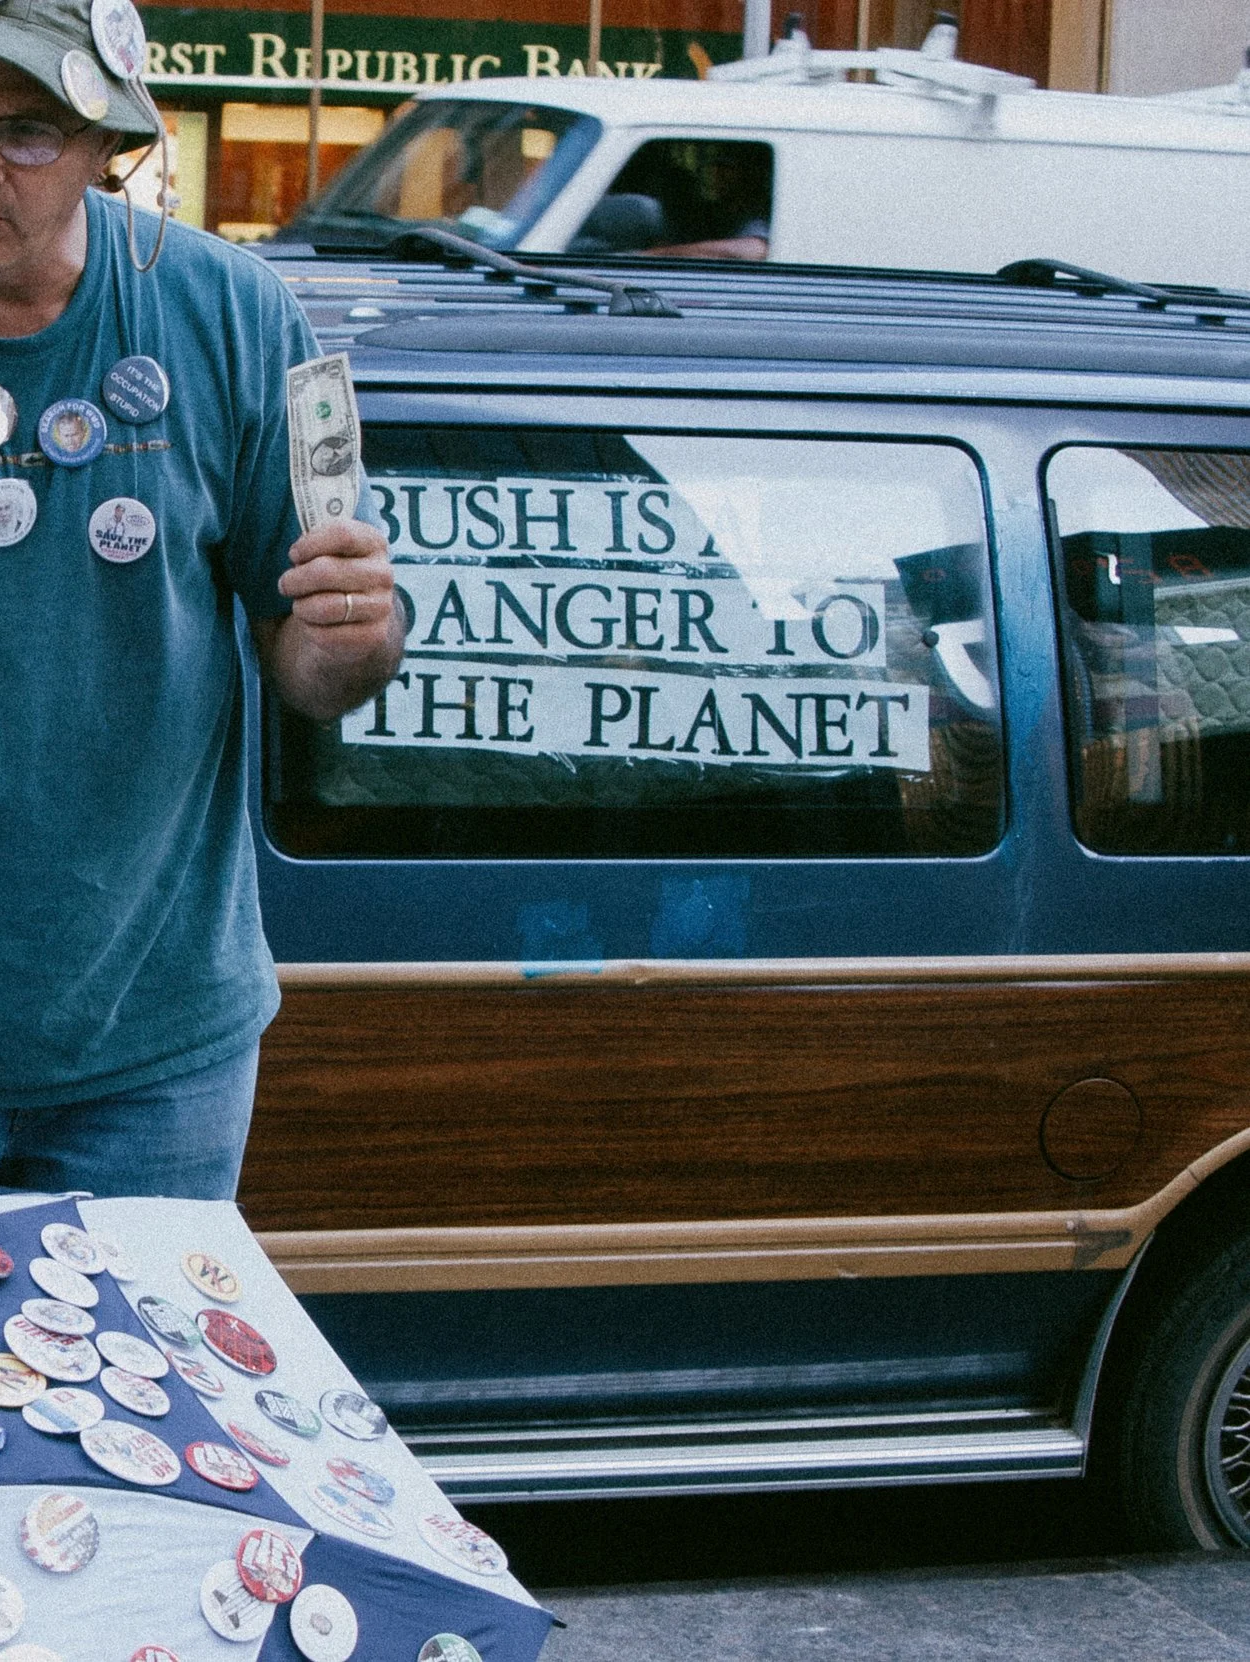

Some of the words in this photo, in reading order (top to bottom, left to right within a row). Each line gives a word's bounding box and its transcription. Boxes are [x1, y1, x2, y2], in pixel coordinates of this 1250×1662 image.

[249, 33, 502, 84] REPUBLIC
[109, 393, 141, 417] STUPID
[110, 372, 162, 412] OCCUPATION
[95, 529, 123, 541] SAVE
[127, 536, 147, 545] THE
[370, 484, 578, 553] BUSH
[603, 489, 676, 555] IS
[98, 539, 140, 552] PLANET
[364, 671, 535, 743] THE
[583, 683, 910, 760] PLANET
